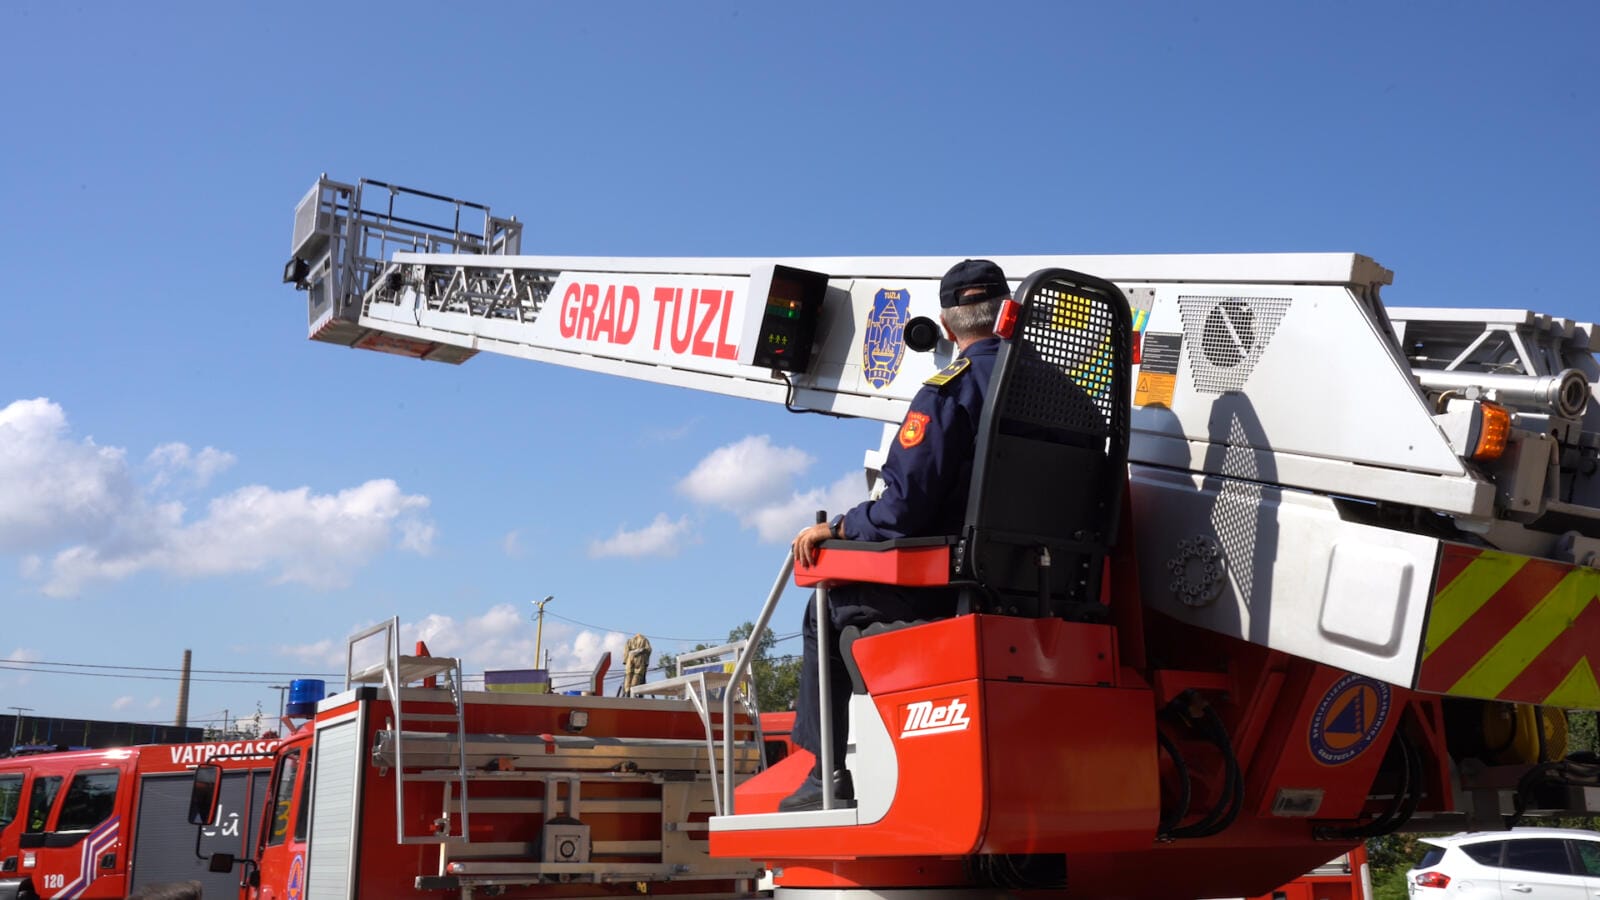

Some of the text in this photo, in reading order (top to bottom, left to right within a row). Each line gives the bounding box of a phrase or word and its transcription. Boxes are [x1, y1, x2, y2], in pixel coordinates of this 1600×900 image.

[884, 291, 901, 301] TUZLA
[559, 282, 740, 361] GRAD TUZL
[900, 698, 971, 739] Metz
[170, 741, 282, 764] VATROGASC
[44, 874, 65, 889] 120
